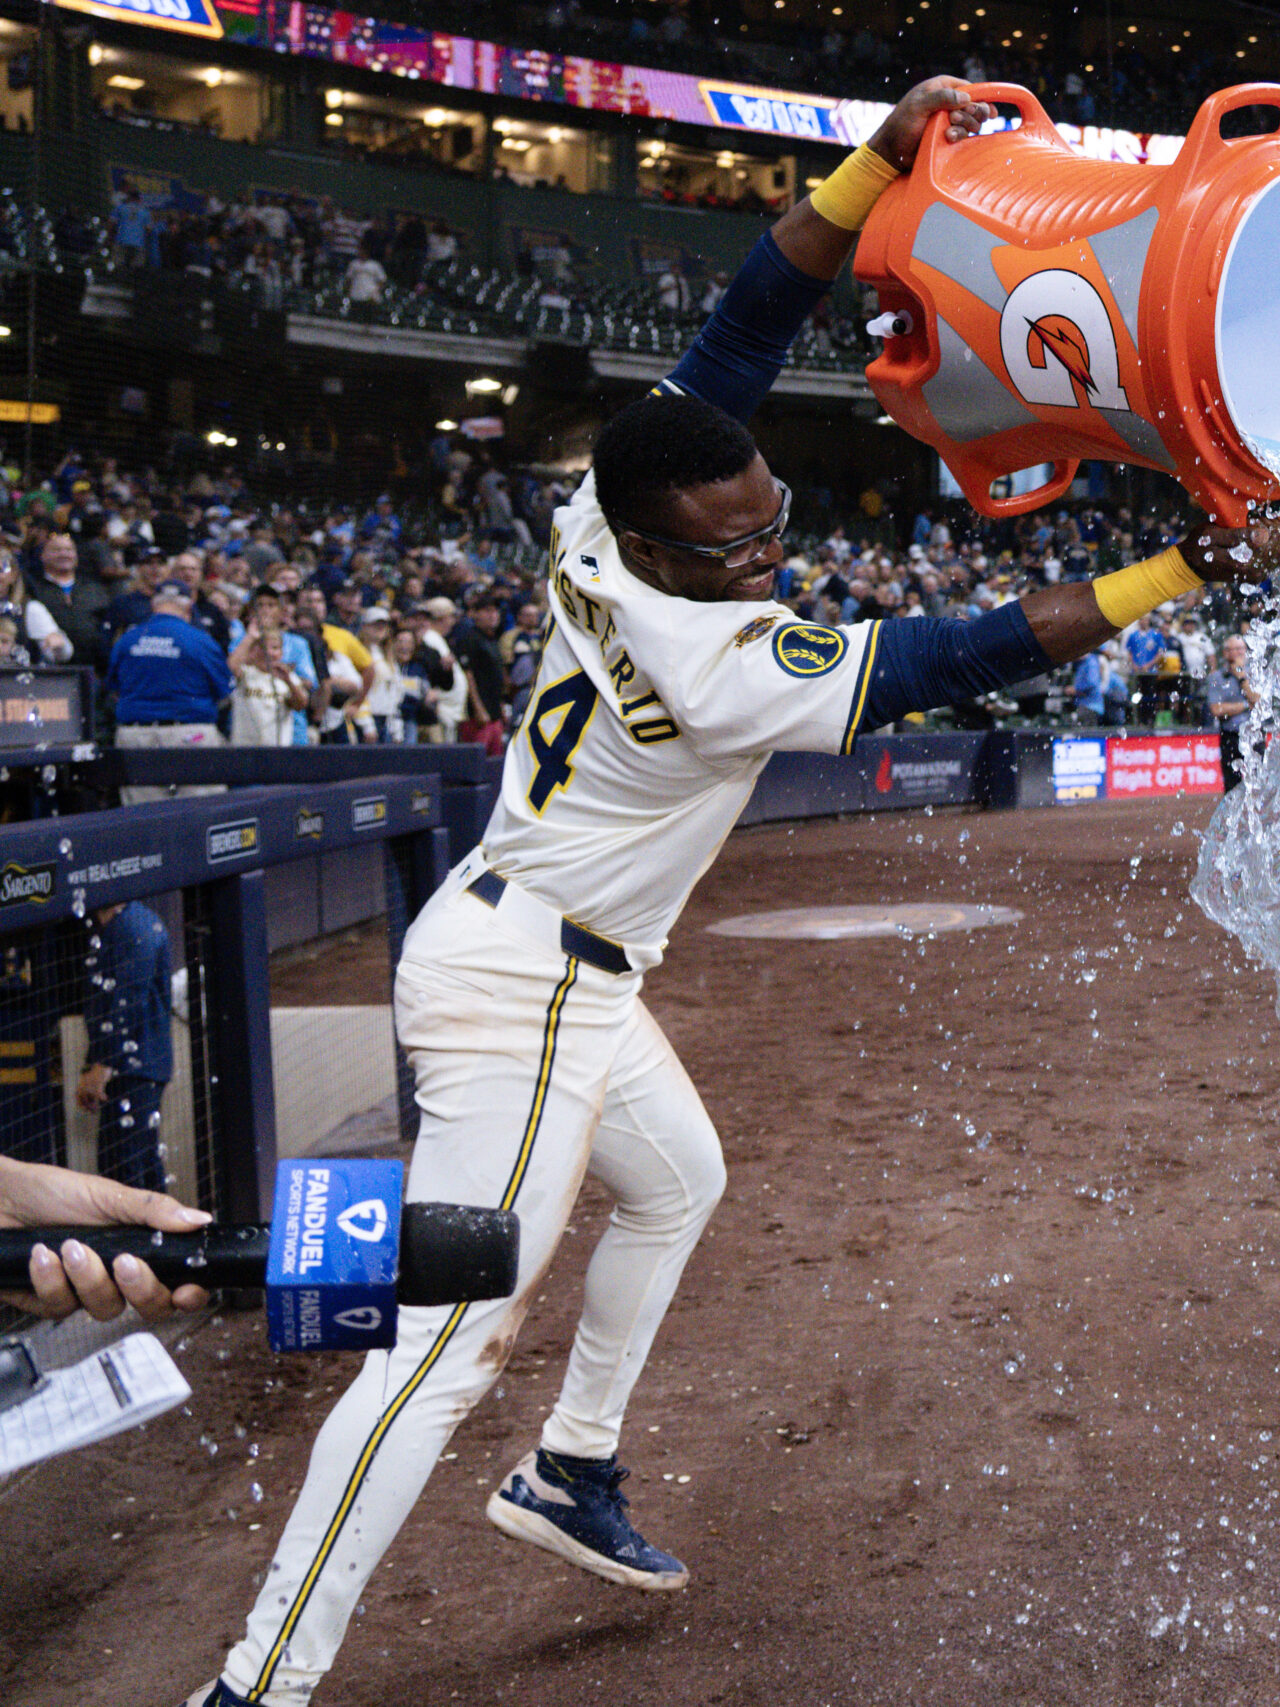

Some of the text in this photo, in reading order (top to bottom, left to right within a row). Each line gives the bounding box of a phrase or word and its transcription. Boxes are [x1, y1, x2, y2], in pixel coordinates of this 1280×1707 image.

[1112, 747, 1156, 766] Home
[1160, 744, 1192, 764] Run
[1112, 768, 1153, 792] Right
[1156, 766, 1183, 787] Off
[1186, 765, 1218, 786] The
[1, 870, 52, 901] SARGENTO
[282, 1169, 304, 1275] SPORTS NETWORK
[299, 1168, 331, 1275] FANDUEL
[299, 1289, 322, 1347] FANDUEL
